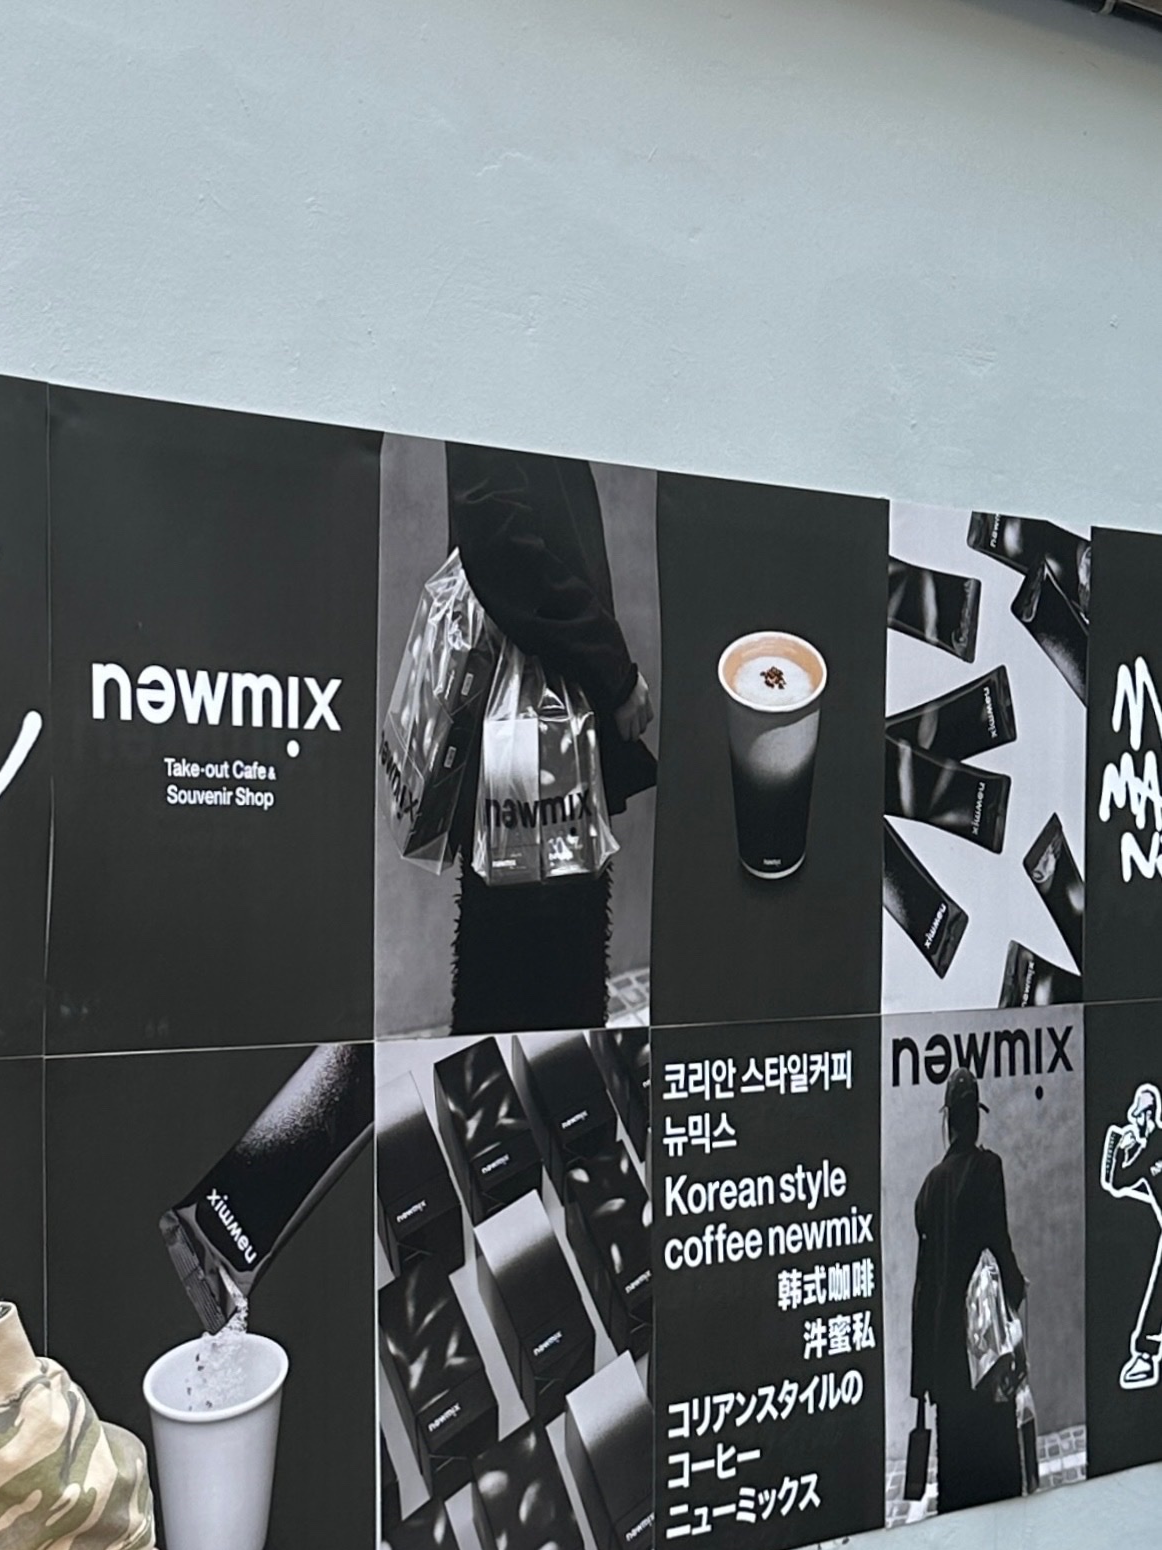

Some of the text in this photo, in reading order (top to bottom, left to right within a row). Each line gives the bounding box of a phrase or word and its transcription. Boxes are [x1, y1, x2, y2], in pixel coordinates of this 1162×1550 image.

[163, 757, 277, 780] Take-out Cafe &
[166, 784, 275, 811] Souvenir Shop
[663, 1050, 852, 1100] 코리안 스타일커피
[663, 1112, 737, 1157] 뉴믹스
[665, 1160, 847, 1217] Korean style
[664, 1206, 874, 1271] coffee newmix
[778, 1258, 875, 1311] 韩式咖啡
[667, 1369, 864, 1439] コリアンスタイルの
[667, 1443, 761, 1488] コーヒー
[666, 1473, 822, 1540] ニューミックス
